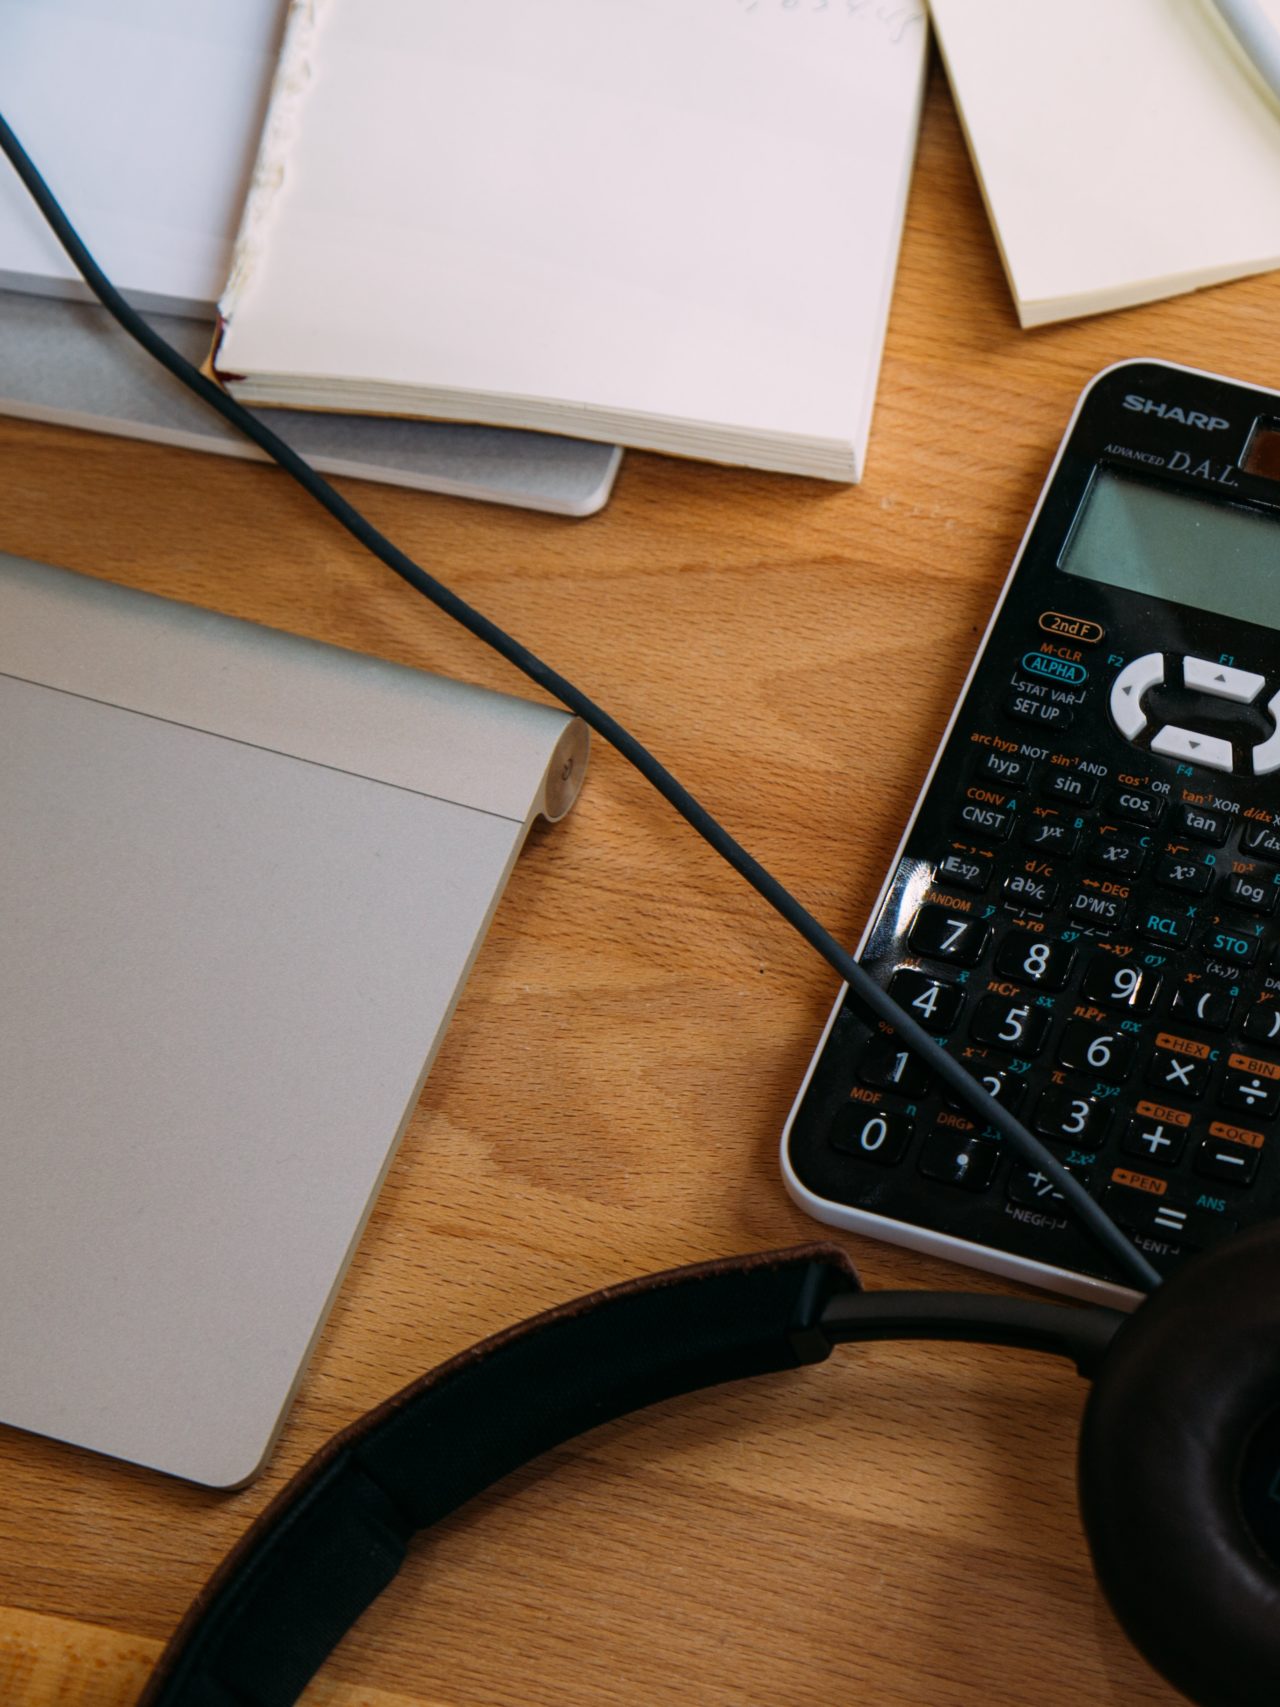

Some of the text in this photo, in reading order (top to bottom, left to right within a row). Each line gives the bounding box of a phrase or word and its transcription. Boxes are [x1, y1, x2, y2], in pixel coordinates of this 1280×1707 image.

[1122, 394, 1230, 431] SHARP
[1103, 443, 1240, 488] ADVANCED D.A.L.
[1051, 617, 1092, 637] 2nd F
[1040, 643, 1083, 662] M-CLR
[1107, 654, 1125, 668] F2
[1219, 653, 1235, 667] F1
[1031, 657, 1077, 681] ALPHA
[1017, 681, 1077, 706] STAT VAR
[1013, 698, 1060, 721] SET UP
[970, 732, 1019, 754] arc hyp
[1020, 744, 1050, 761] NOT
[987, 752, 1020, 777] hyp
[1077, 760, 1108, 777] AND
[1176, 763, 1194, 778] F4
[1054, 776, 1082, 795] sin
[1151, 781, 1171, 795] OR
[966, 787, 1006, 806] CONV
[1006, 799, 1018, 811] A
[1119, 794, 1150, 812] cos
[1212, 797, 1241, 815] XOR
[962, 805, 1006, 829] CNST
[1073, 817, 1084, 830] B
[1185, 811, 1217, 833] tan
[1243, 807, 1274, 824] d/dx
[1139, 836, 1151, 848] C
[944, 854, 981, 881] Exp
[1024, 860, 1054, 877] d/c
[1204, 853, 1217, 866] D
[1101, 881, 1131, 899] DEG
[1235, 878, 1266, 903] log
[1185, 905, 1198, 919] X
[938, 918, 970, 950] 7
[1146, 914, 1179, 937] RCL
[1254, 924, 1265, 938] Y
[1213, 933, 1250, 955] STO
[1022, 943, 1051, 976] 8
[1205, 961, 1240, 981] (x,y)
[986, 980, 1021, 998] nCr
[1110, 967, 1139, 1000] 9
[1229, 985, 1241, 997] a
[911, 985, 939, 1019] 4
[1072, 1004, 1108, 1022] nPr
[997, 1007, 1030, 1042] 5
[1086, 1036, 1115, 1068] 6
[1173, 1039, 1206, 1056] HEX
[1209, 1049, 1221, 1062] c
[893, 1051, 910, 1084] 1
[1247, 1060, 1276, 1078] BIN
[850, 1087, 883, 1105] MDF
[905, 1104, 918, 1117] n
[1060, 1100, 1090, 1134] 3
[1153, 1106, 1187, 1126] DEC
[936, 1112, 967, 1131] DRG
[860, 1117, 888, 1151] 0
[1227, 1127, 1260, 1145] OCT
[1129, 1174, 1163, 1193] PEN
[1196, 1194, 1227, 1213] ANS
[1141, 1238, 1171, 1255] ENT
